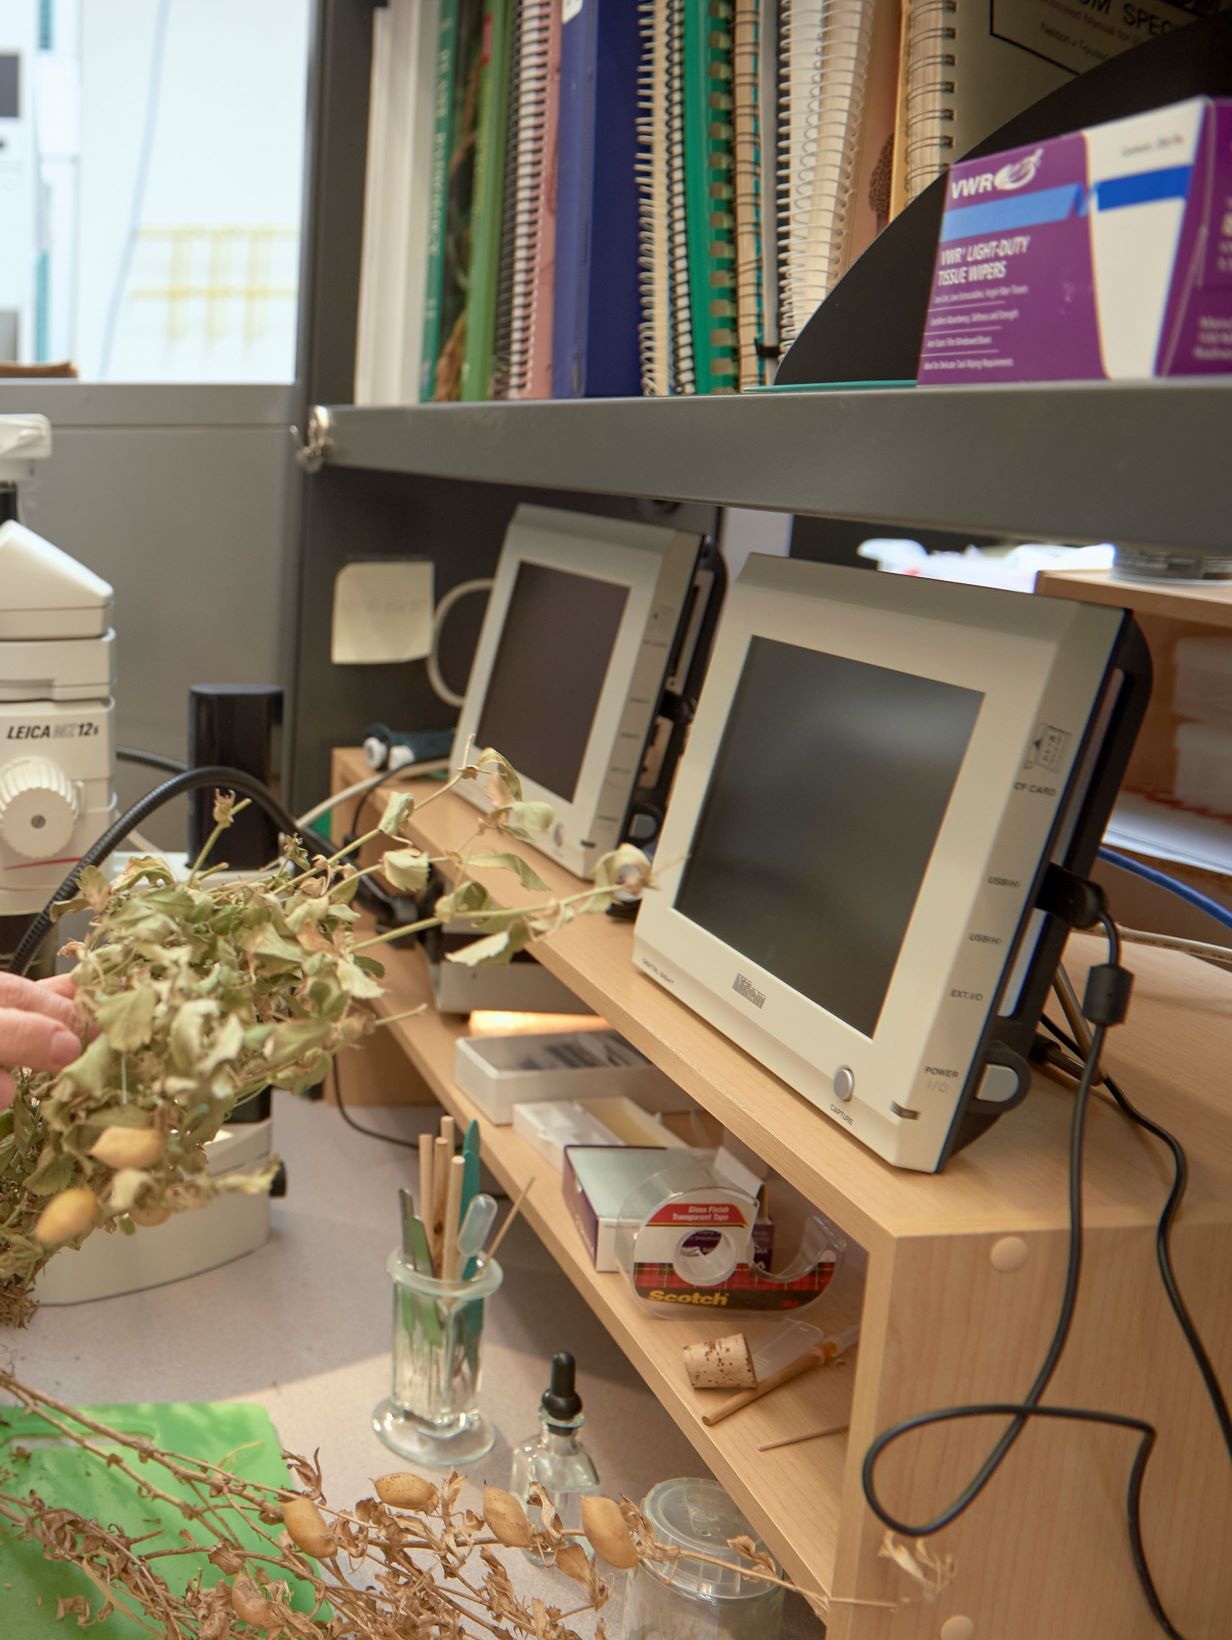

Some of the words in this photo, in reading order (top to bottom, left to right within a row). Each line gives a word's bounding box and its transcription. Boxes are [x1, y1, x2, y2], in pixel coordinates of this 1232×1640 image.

[951, 172, 994, 199] VWR
[967, 235, 1030, 262] LIGHT-DUTY
[938, 266, 968, 286] TISSUE
[968, 260, 1008, 282] WIPERS
[6, 724, 51, 740] LEICA
[925, 1065, 959, 1080] POWER
[830, 1104, 855, 1127] CAPTURE
[672, 1213, 712, 1222] Transparent
[713, 1213, 729, 1222] Tape
[708, 1205, 729, 1214] Finish
[648, 1290, 729, 1306] Scotch
